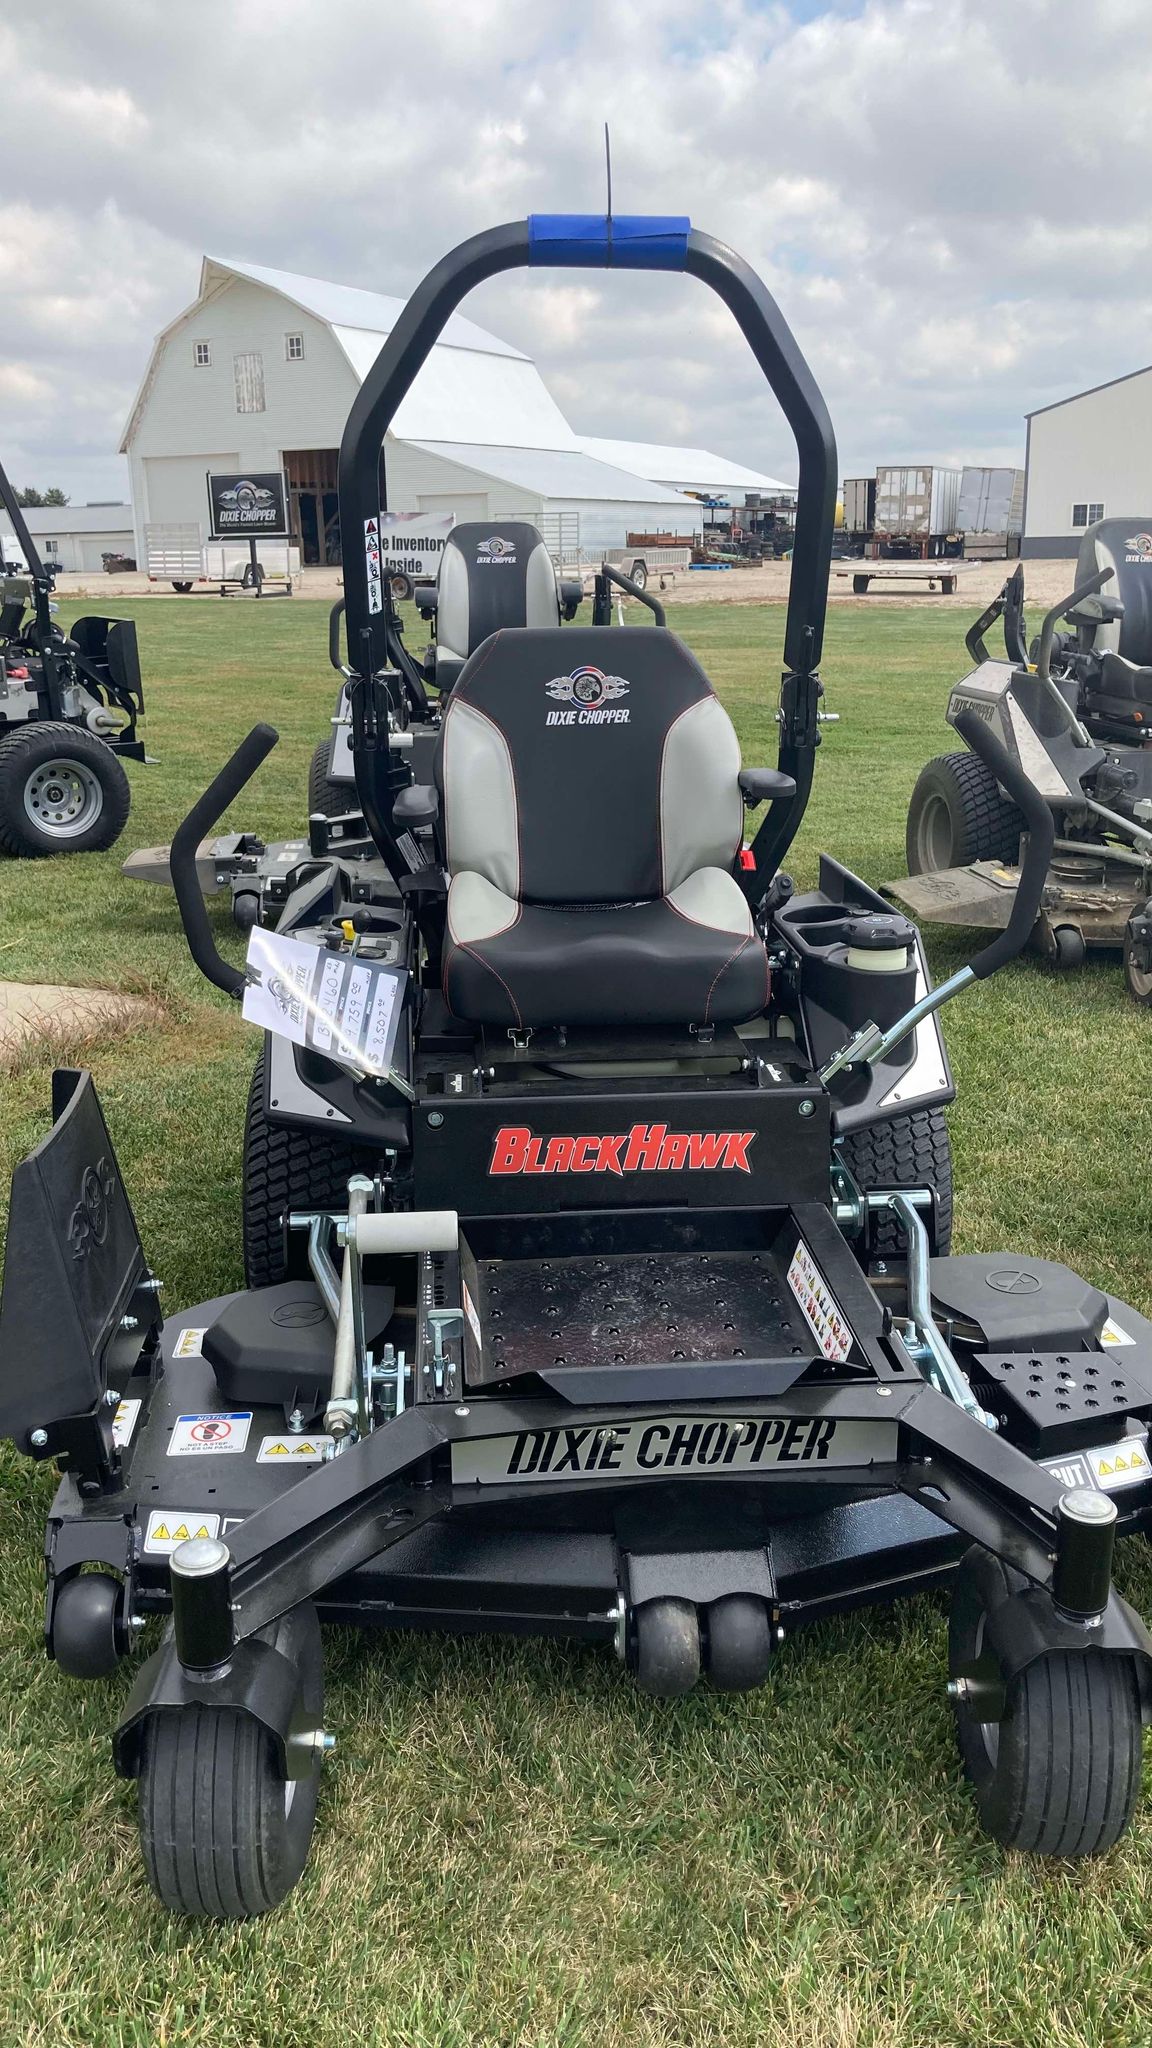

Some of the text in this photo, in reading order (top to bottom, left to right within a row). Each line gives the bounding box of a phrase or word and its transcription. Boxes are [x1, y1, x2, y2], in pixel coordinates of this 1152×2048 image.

[220, 509, 277, 522] DIXIE CHOPPER
[392, 536, 446, 551] Inventory
[546, 709, 630, 726] DIXIE CHOPPER
[506, 1419, 838, 1475] DIXIE CHOPPER
[1048, 1463, 1085, 1488] CUT
